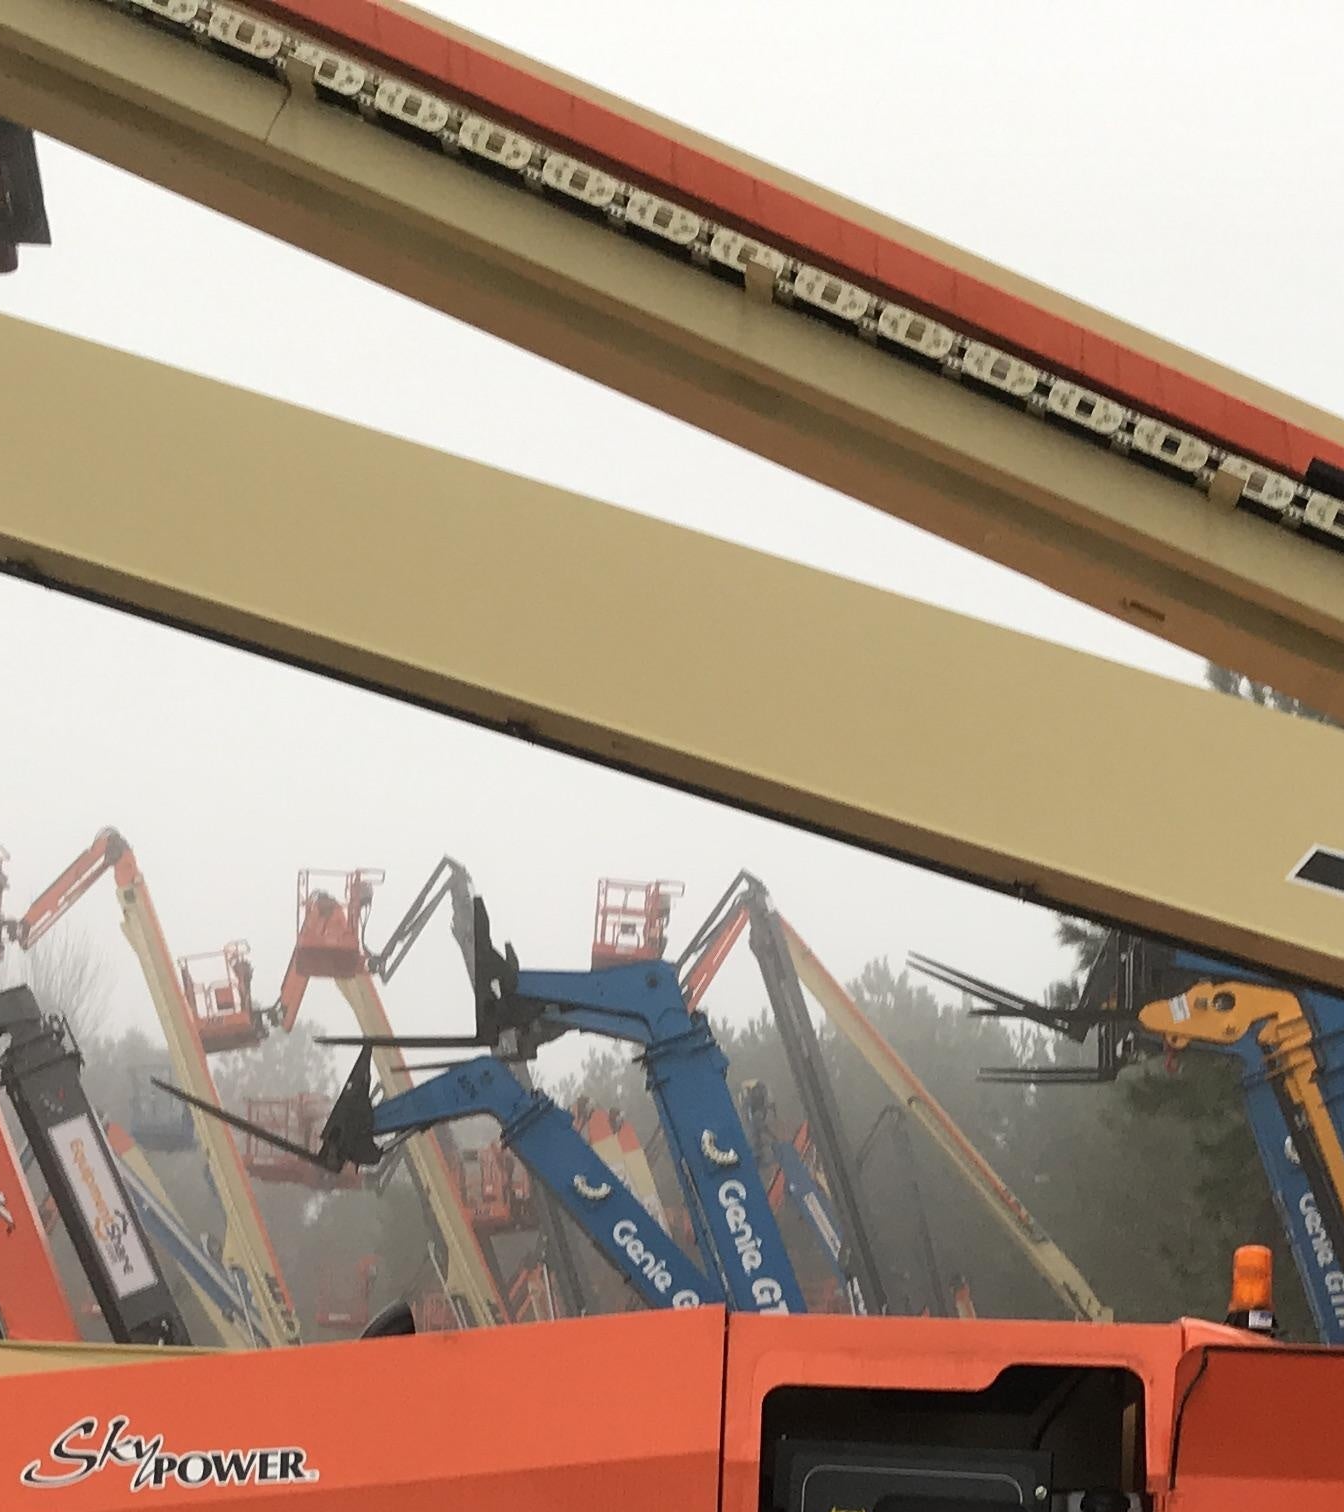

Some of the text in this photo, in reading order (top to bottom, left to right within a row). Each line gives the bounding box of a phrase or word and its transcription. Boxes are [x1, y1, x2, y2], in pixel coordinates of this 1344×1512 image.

[613, 1219, 701, 1311] Genie G
[718, 1179, 762, 1276] Genie
[1299, 1192, 1334, 1268] Genie
